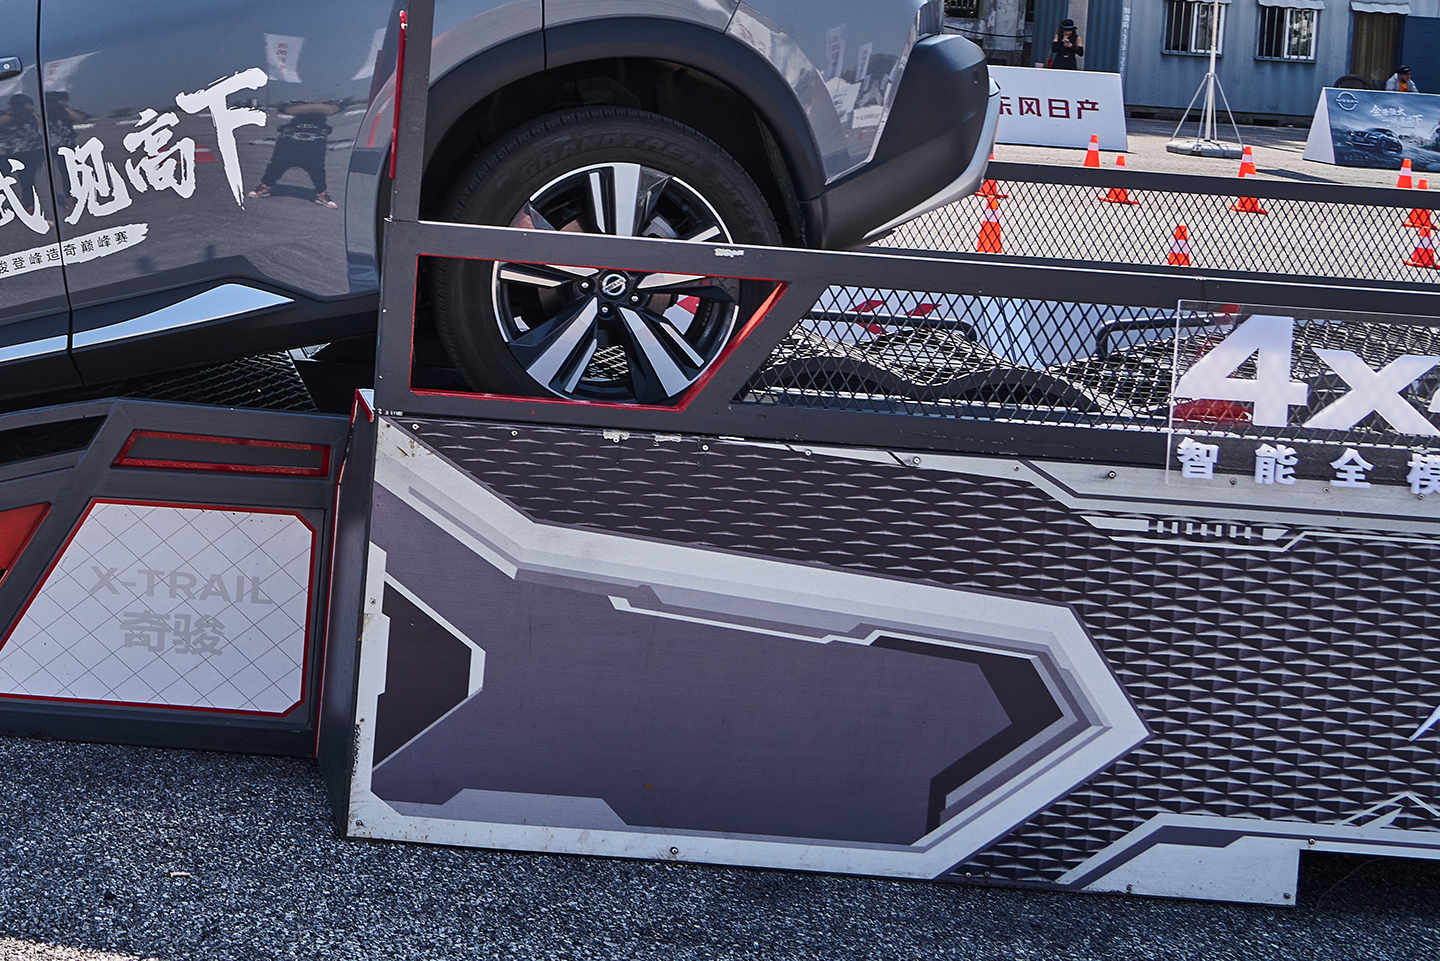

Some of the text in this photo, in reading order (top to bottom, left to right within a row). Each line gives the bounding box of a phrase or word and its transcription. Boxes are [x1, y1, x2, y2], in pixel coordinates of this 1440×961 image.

[1173, 314, 1440, 437] 4x
[89, 565, 273, 605] X-TRAIL
[119, 610, 226, 657] 奇骏
